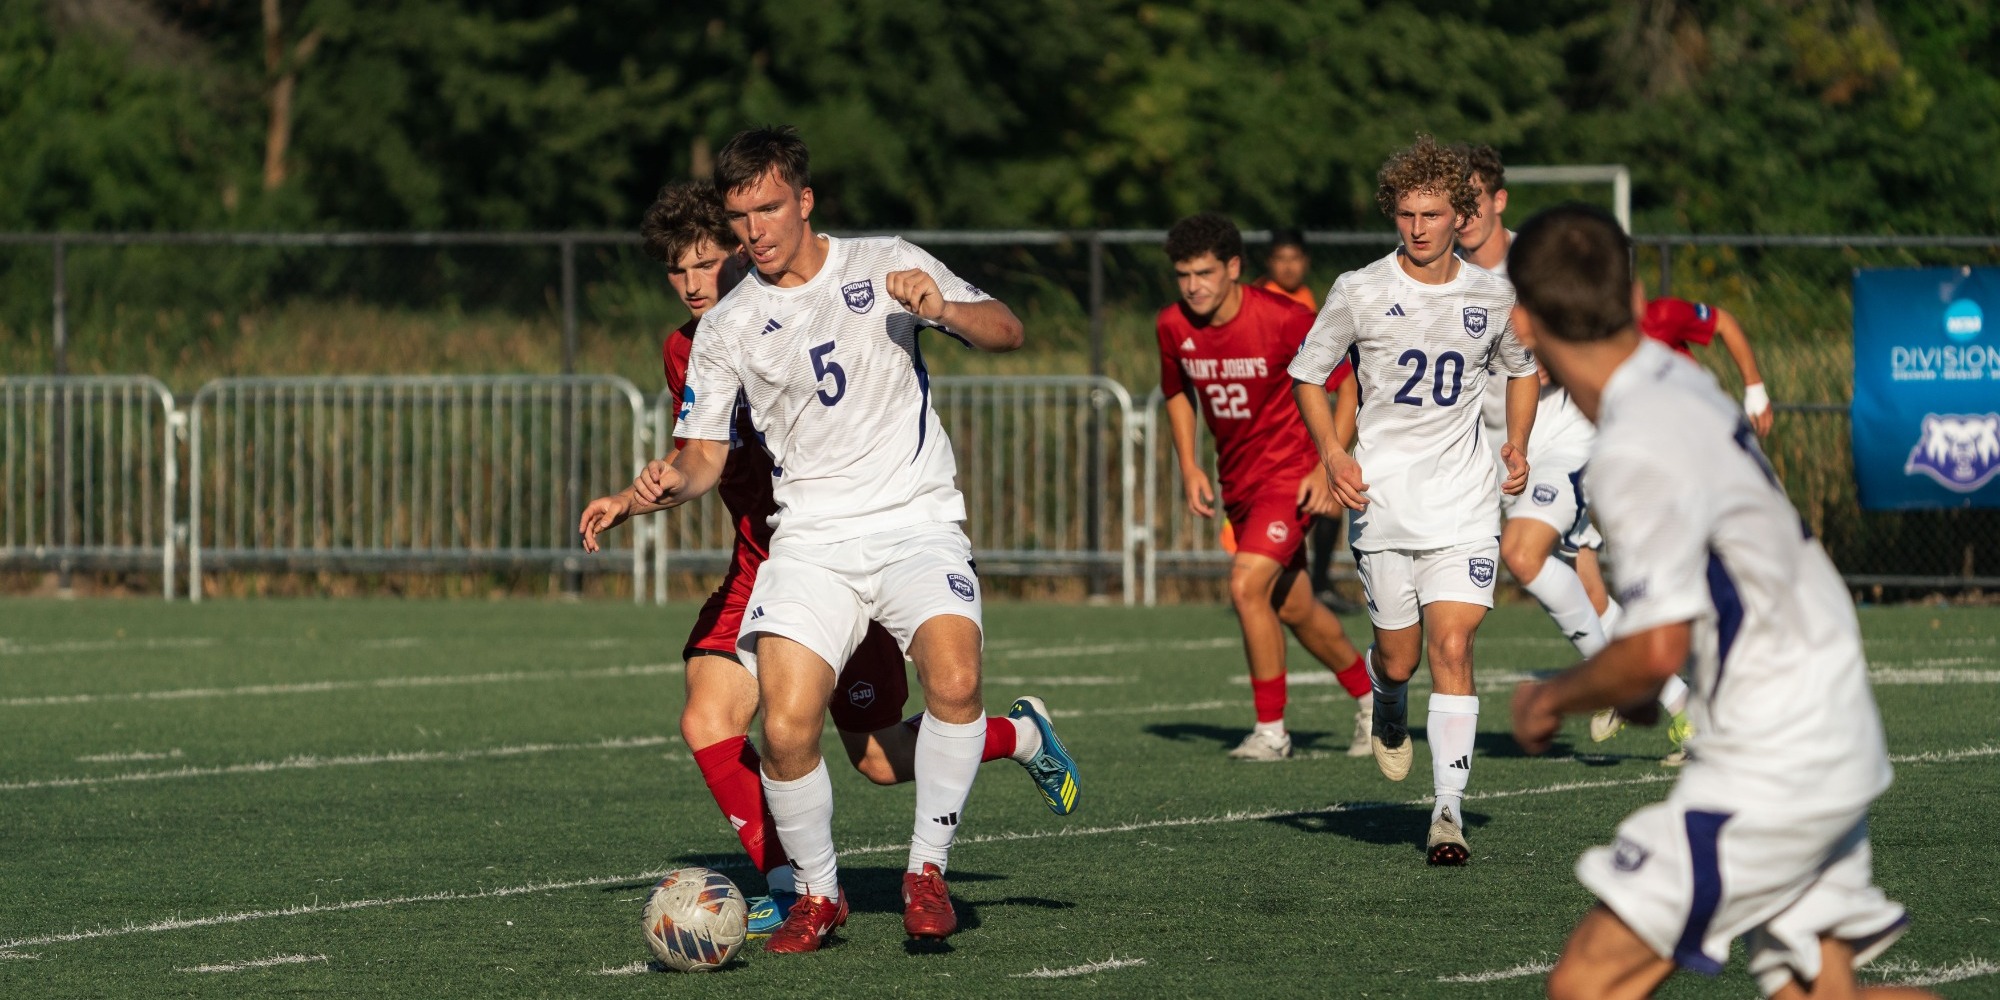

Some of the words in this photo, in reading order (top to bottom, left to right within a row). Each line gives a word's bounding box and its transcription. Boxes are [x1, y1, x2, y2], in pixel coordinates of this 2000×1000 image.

[843, 281, 870, 294] CROWN
[1465, 307, 1486, 316] CROWN
[1220, 357, 1268, 379] JOHN'S
[1892, 345, 2000, 369] DIVISION
[809, 340, 846, 406] 5
[1394, 349, 1464, 407] 20
[1205, 383, 1251, 419] 22
[1471, 559, 1493, 567] CROWN
[852, 689, 871, 700] SJU
